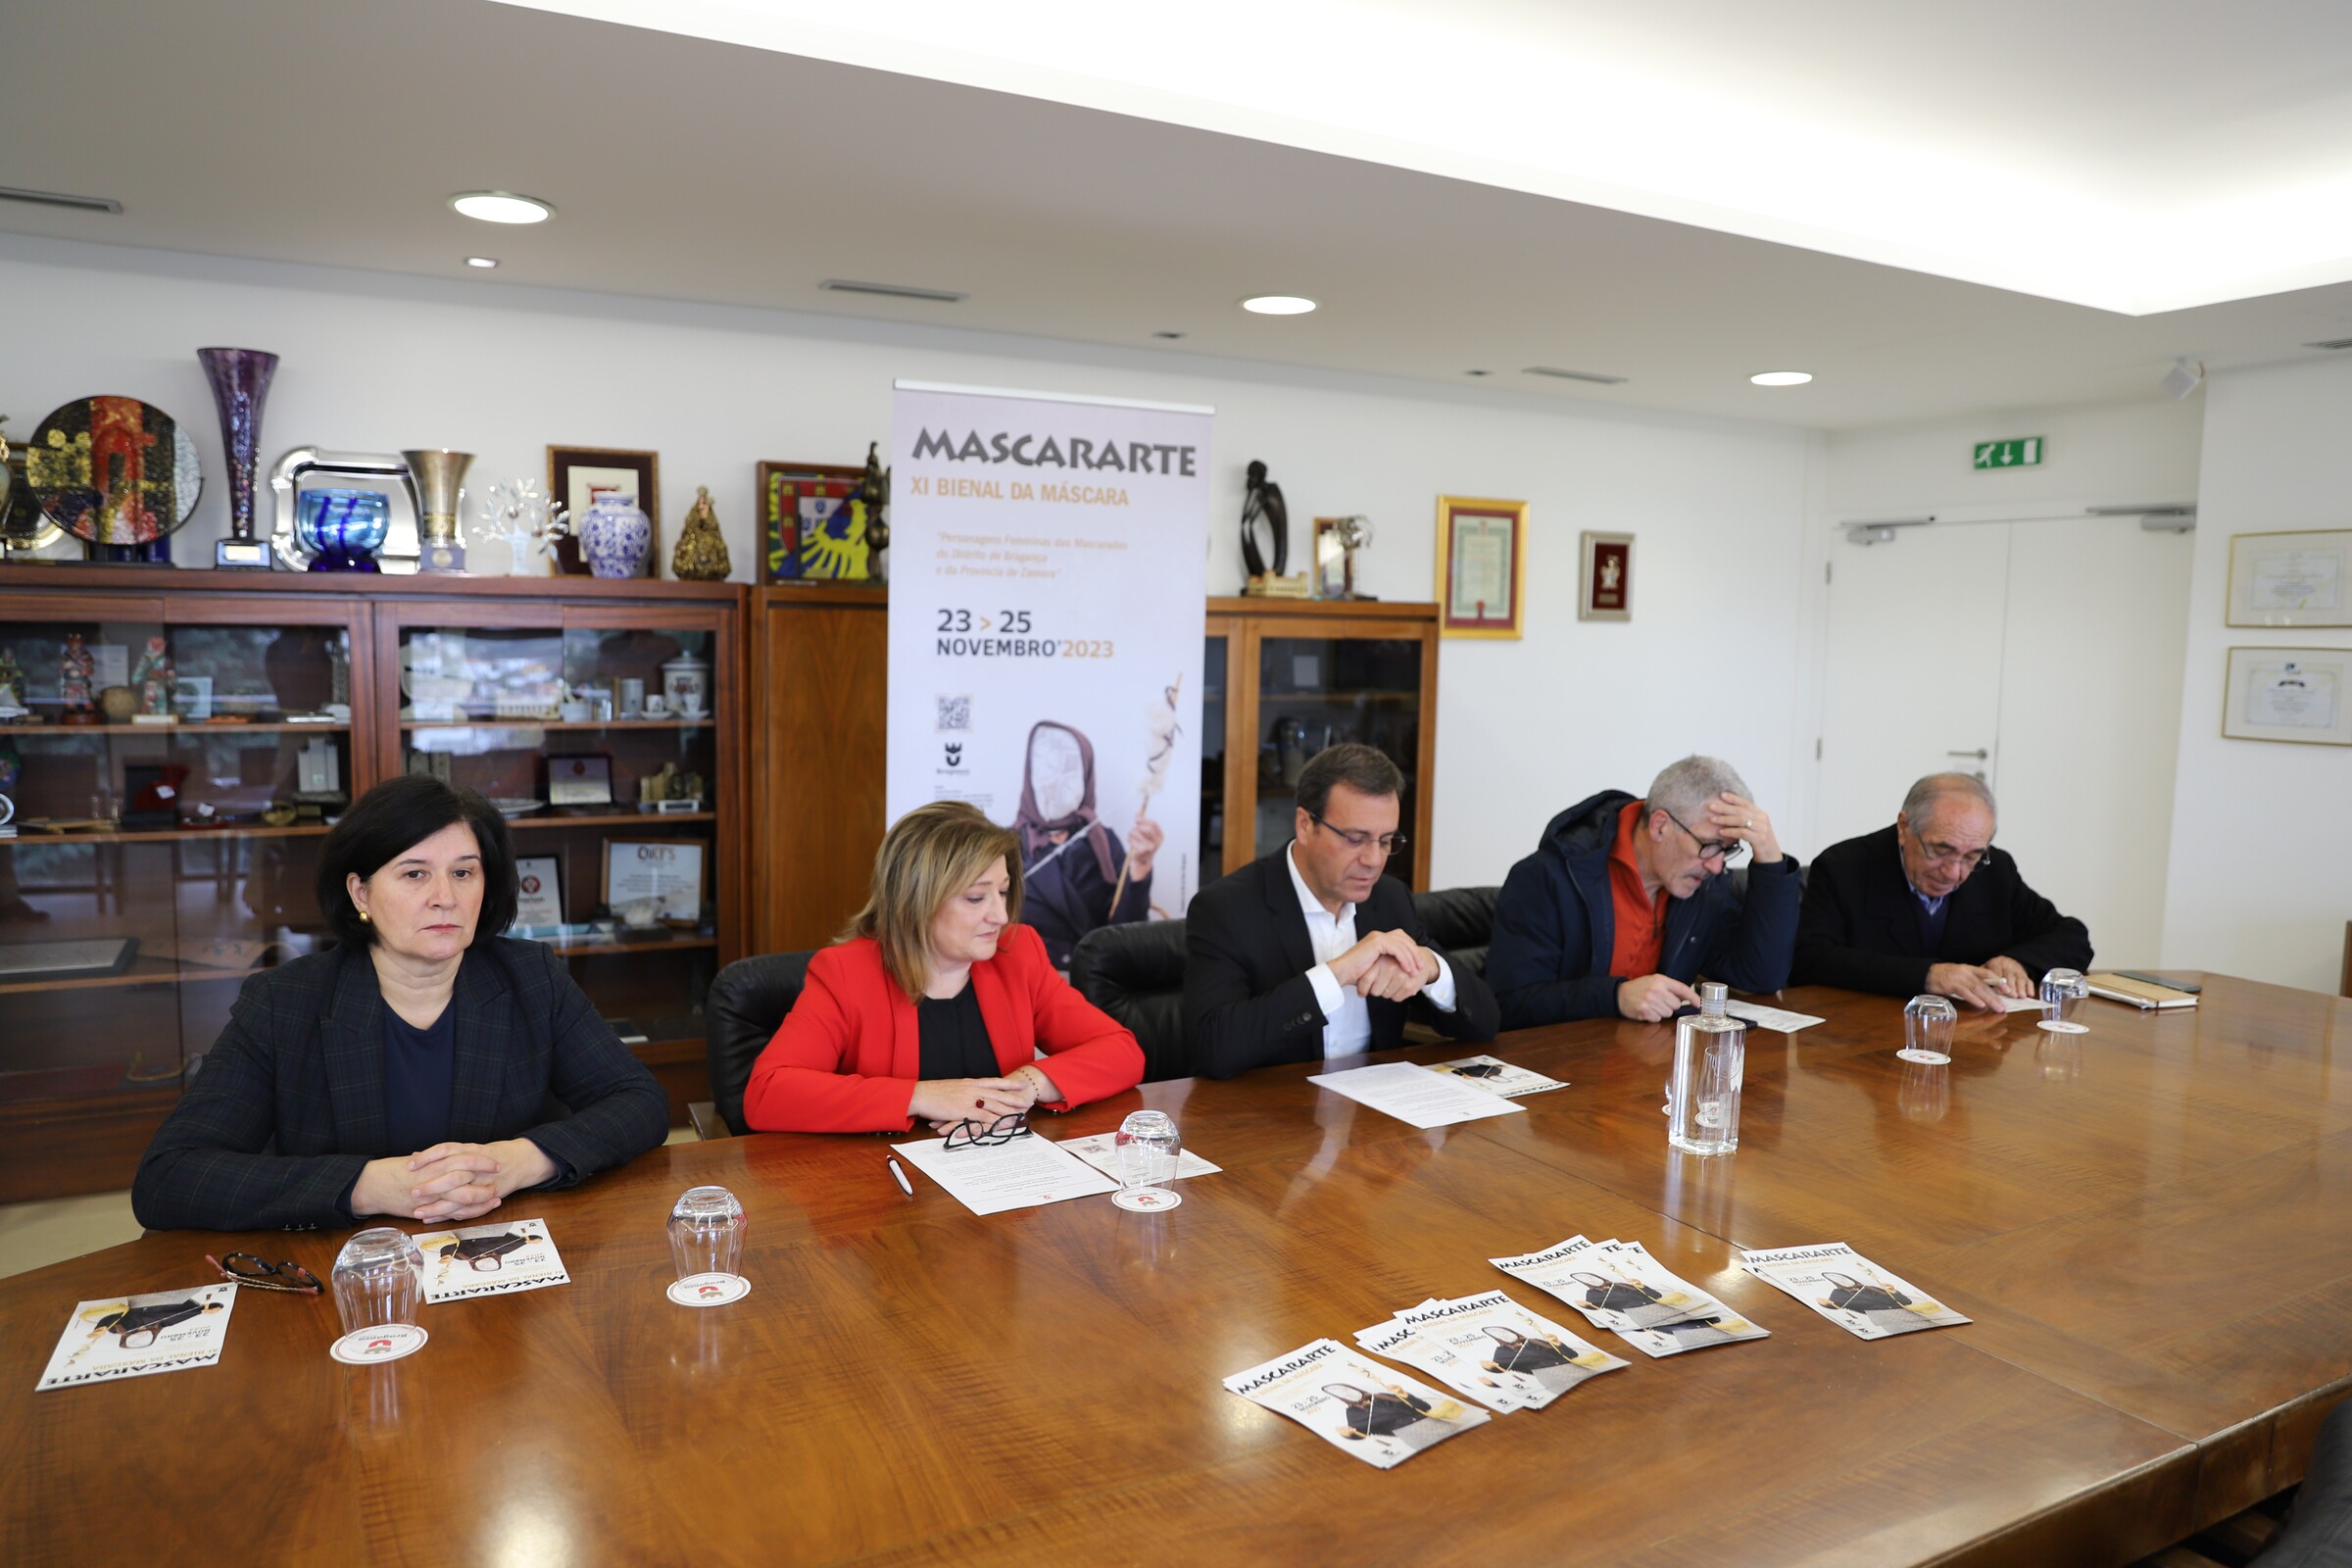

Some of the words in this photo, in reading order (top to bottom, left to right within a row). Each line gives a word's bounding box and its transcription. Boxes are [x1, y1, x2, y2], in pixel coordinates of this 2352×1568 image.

[911, 427, 1196, 476] MASCARARTE
[911, 476, 929, 496] XI
[937, 478, 1004, 500] BIENAL
[1011, 482, 1034, 501] DA
[1041, 481, 1129, 506] MÁSCARA
[938, 609, 971, 632] 23
[1000, 611, 1032, 633] 25
[1499, 1240, 1591, 1270] MASCARARTE
[1749, 1248, 1852, 1263] MASCARARTE
[430, 1275, 565, 1299] MASCARARTE
[1405, 1295, 1510, 1325] MASCARARTE
[45, 1352, 218, 1386] MASCARARTE
[1237, 1346, 1337, 1395] MASCARARTE
